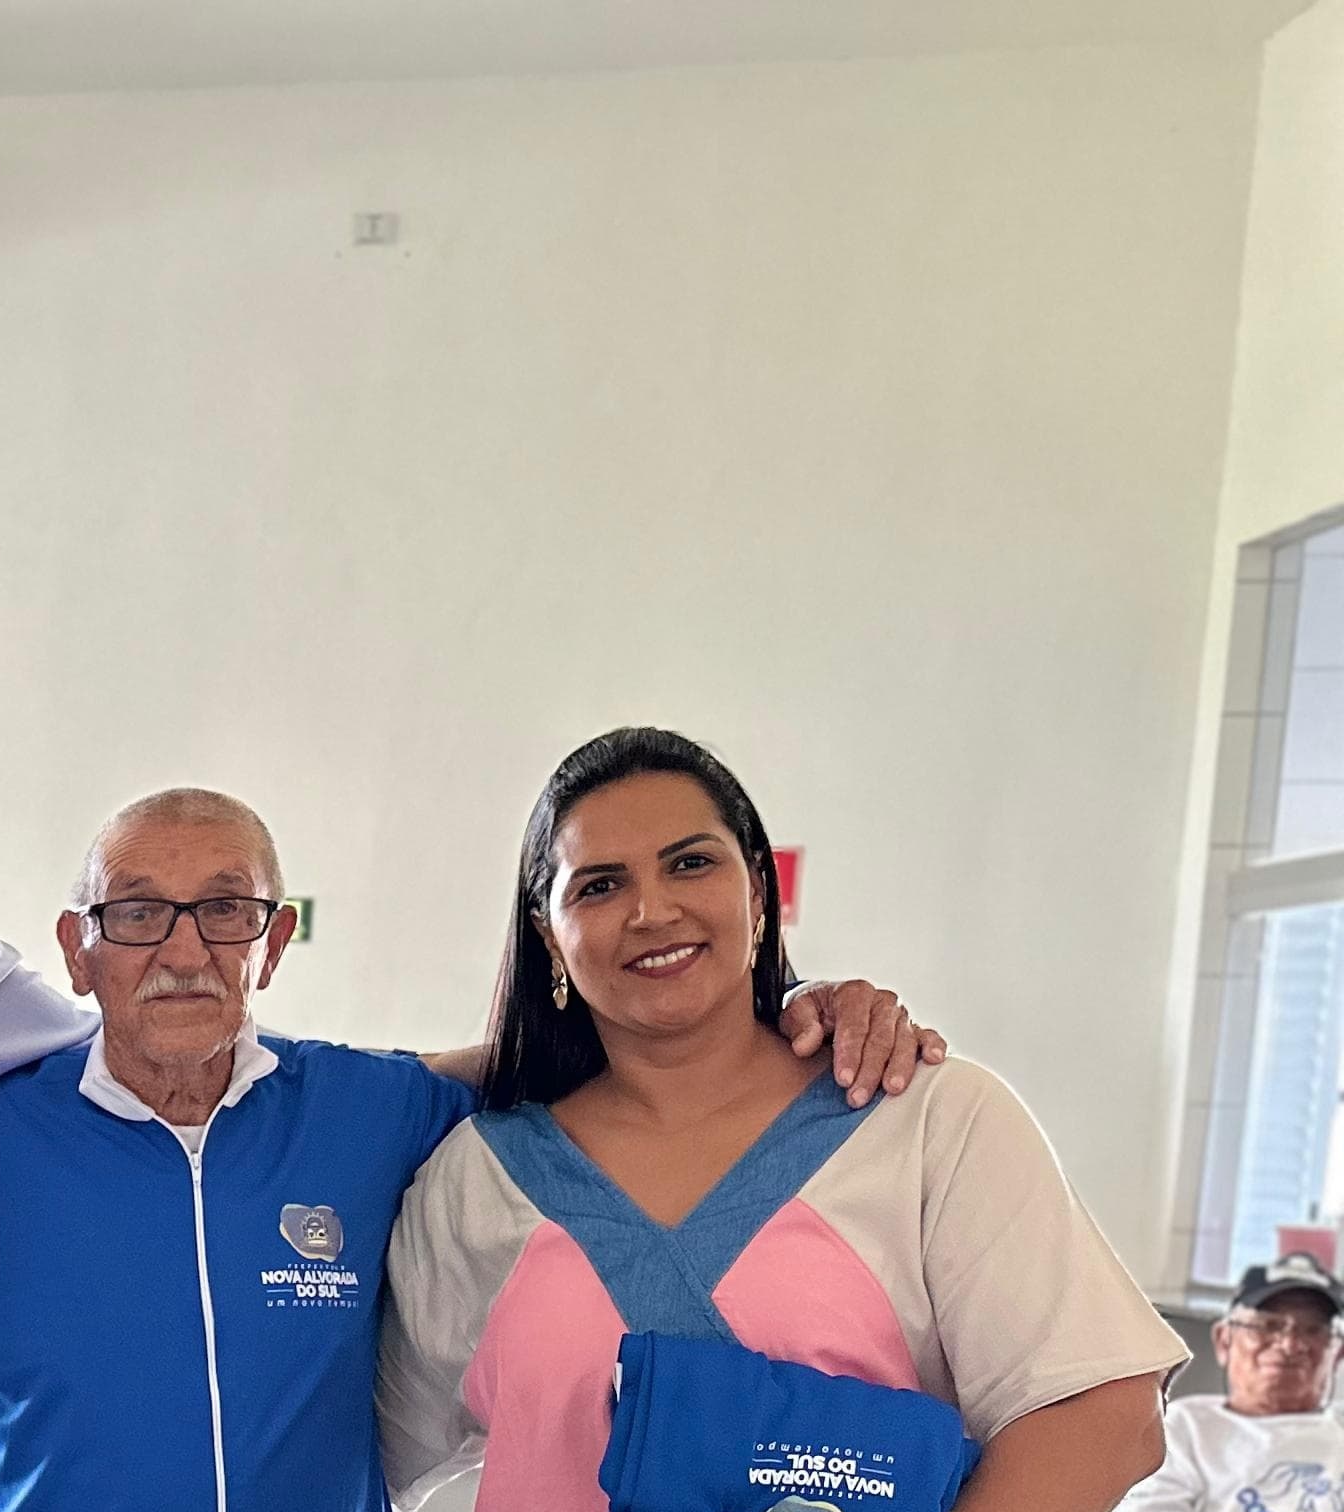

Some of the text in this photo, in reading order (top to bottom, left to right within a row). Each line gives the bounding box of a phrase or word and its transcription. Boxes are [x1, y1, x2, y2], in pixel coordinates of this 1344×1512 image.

[261, 1270, 359, 1286] NOVA ALVORADA
[296, 1284, 341, 1298] DO SUL
[267, 1300, 286, 1308] um
[292, 1299, 323, 1307] novo
[821, 1445, 864, 1459] novo
[872, 1453, 894, 1464] um
[786, 1453, 857, 1475] DO SUL
[749, 1467, 895, 1498] NOVA ALVORADA
